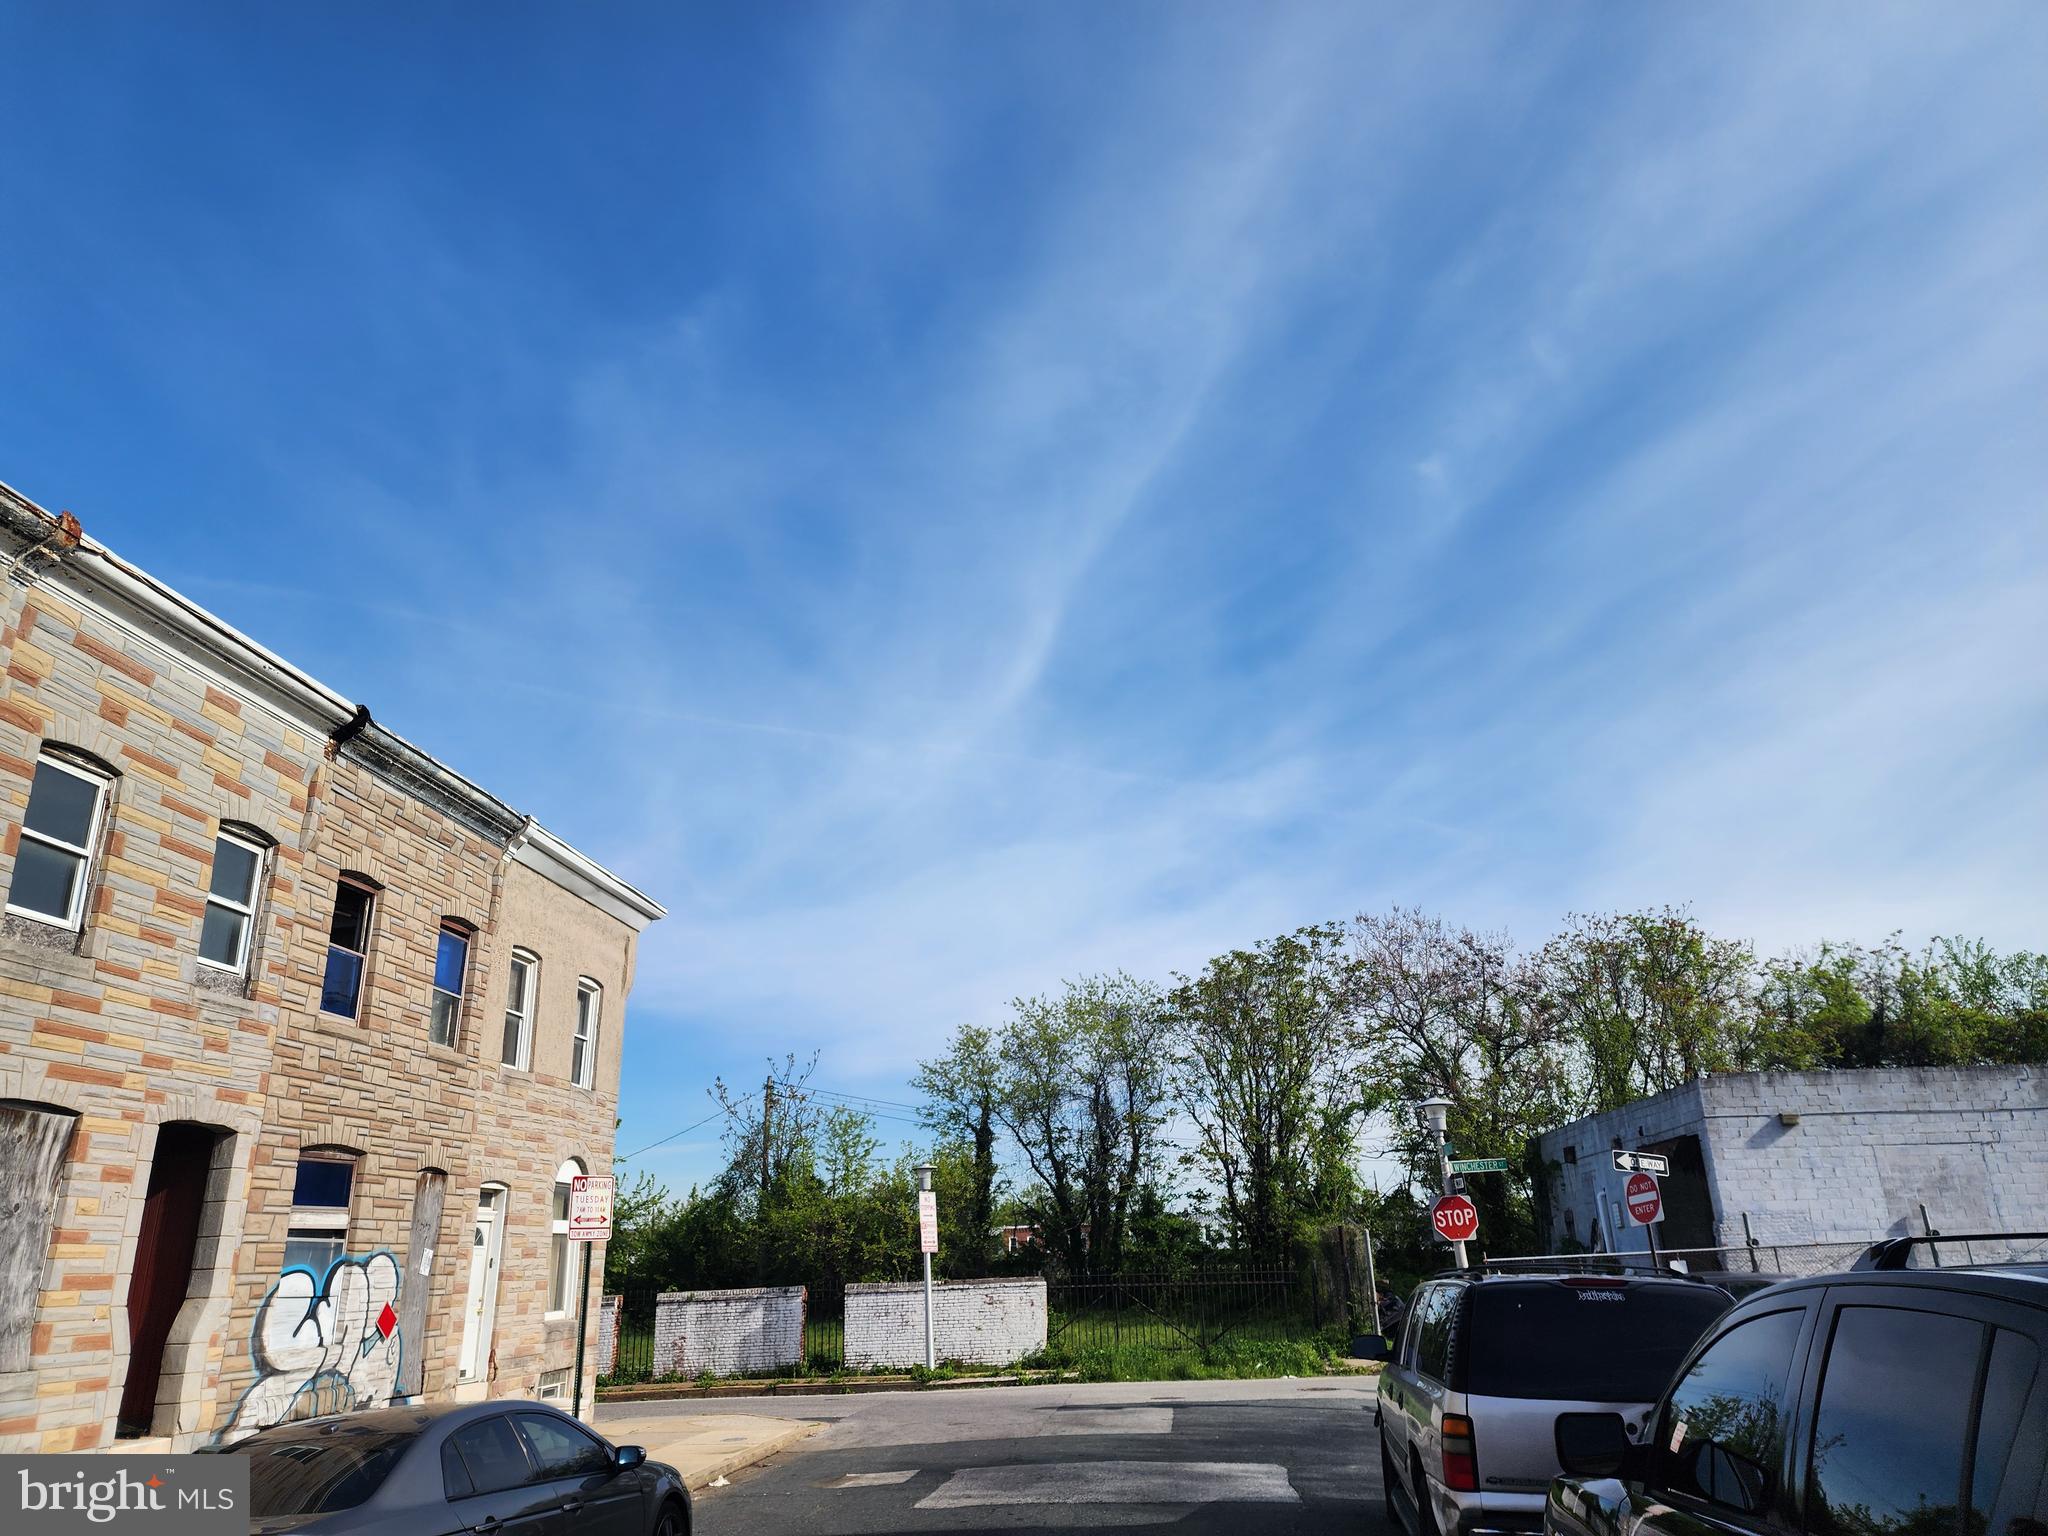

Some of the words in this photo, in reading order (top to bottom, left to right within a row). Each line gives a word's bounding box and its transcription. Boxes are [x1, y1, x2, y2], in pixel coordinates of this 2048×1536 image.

[1453, 1161, 1499, 1171] WINCHESTER
[1648, 1160, 1662, 1168] WAY
[574, 1179, 587, 1191] NO
[588, 1180, 611, 1190] PARKING
[1629, 1185, 1638, 1193] DO
[1640, 1181, 1652, 1191] NOT
[576, 1195, 609, 1203] TUESDAY
[1635, 1204, 1655, 1215] ENTER
[1436, 1208, 1473, 1228] STOP
[571, 1230, 581, 1238] TOW
